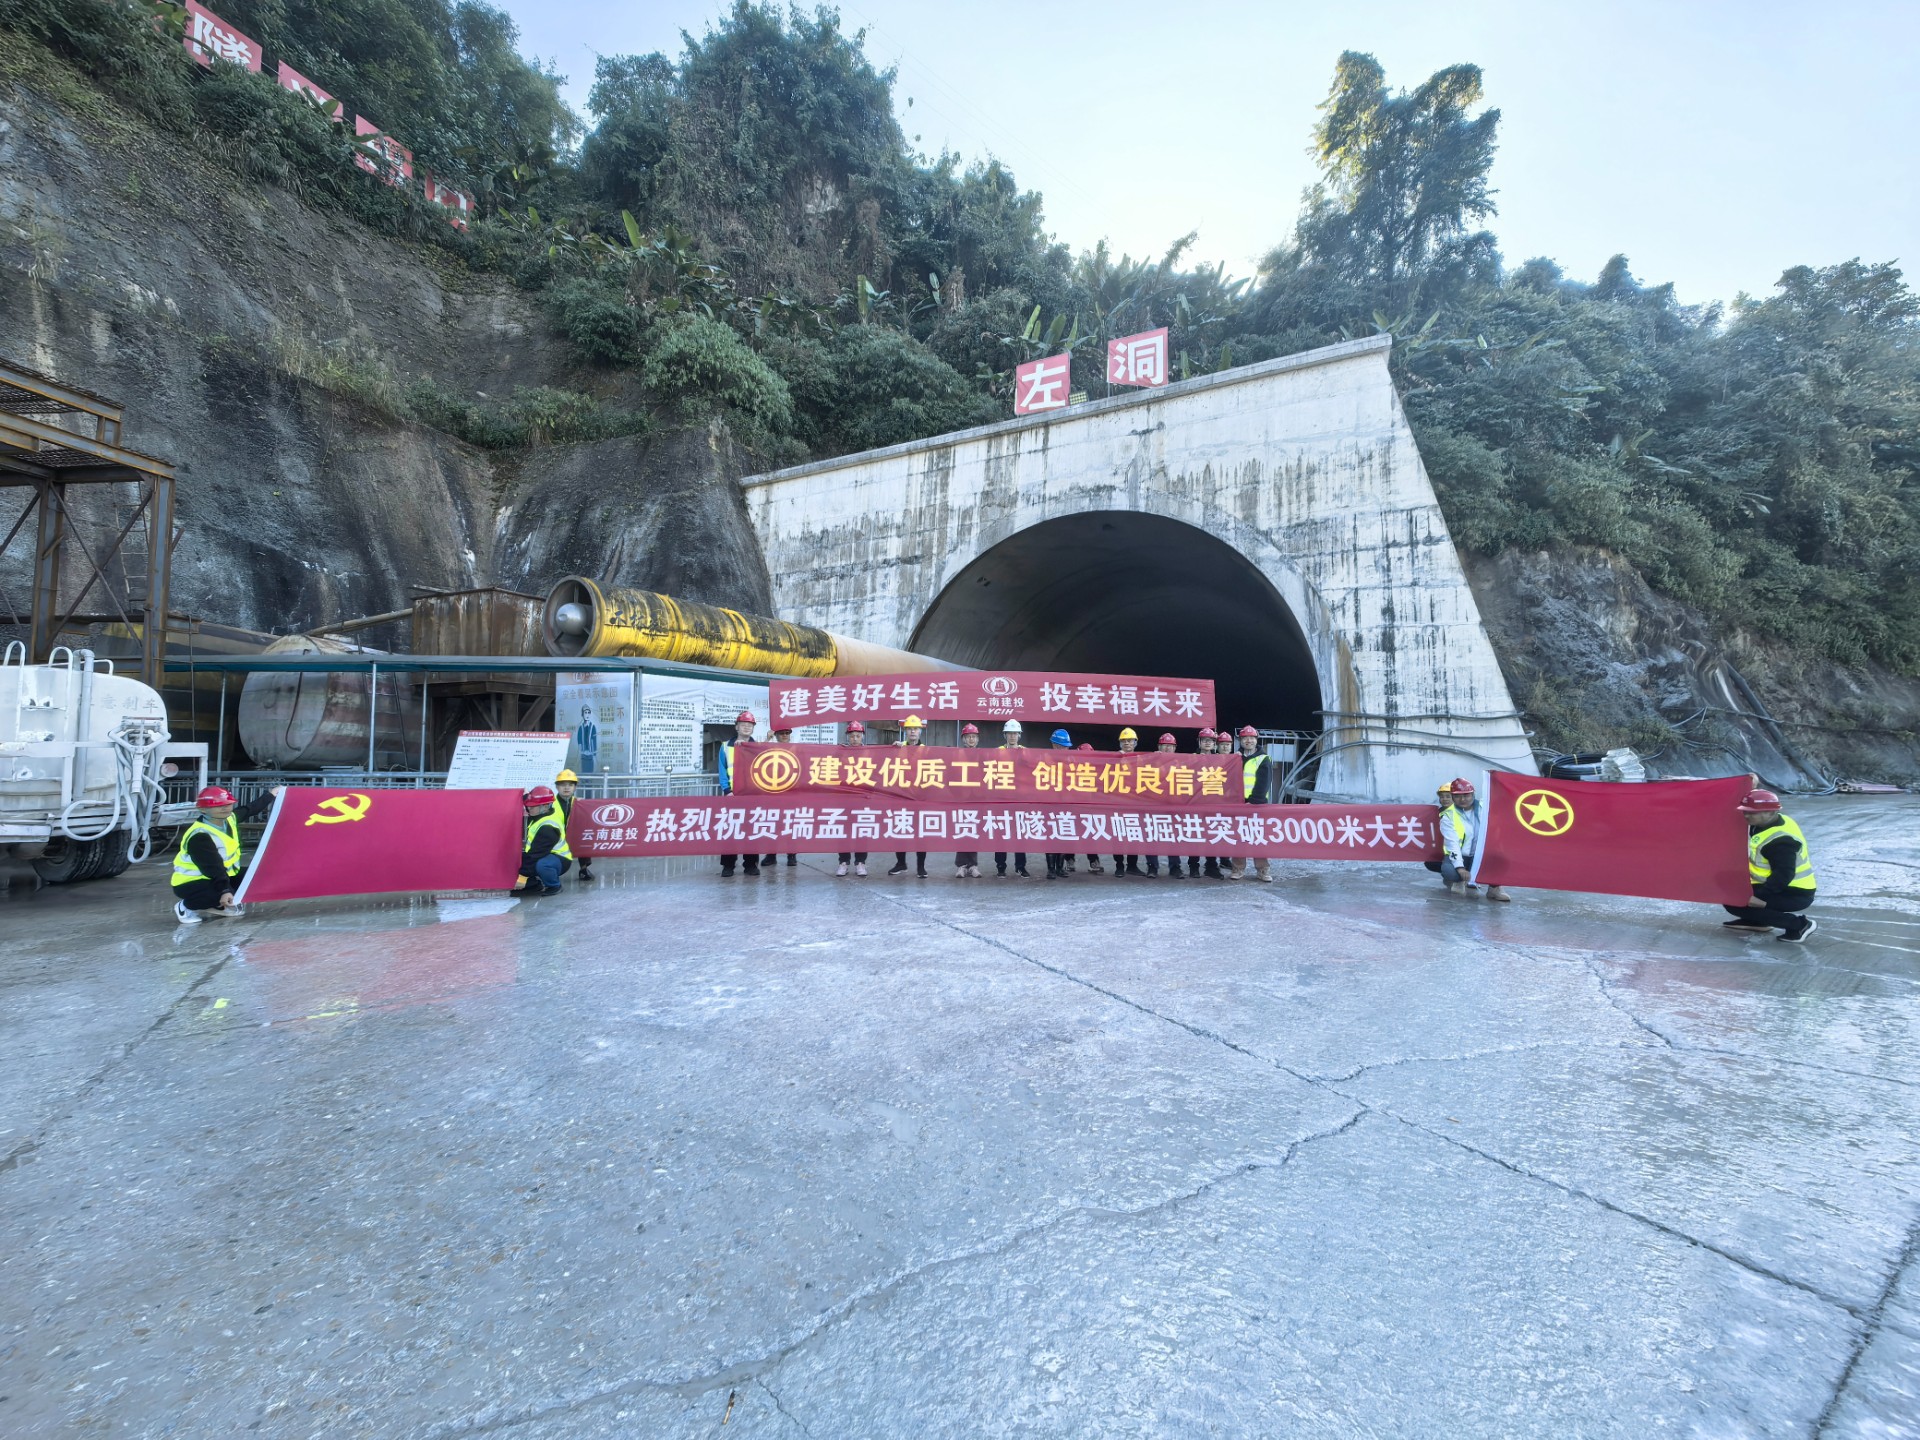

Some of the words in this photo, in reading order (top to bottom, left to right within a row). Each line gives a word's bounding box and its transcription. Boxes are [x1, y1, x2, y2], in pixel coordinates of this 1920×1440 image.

[1021, 363, 1066, 410] 左
[1113, 335, 1164, 384] 洞
[780, 681, 960, 719] 建美好生活
[1040, 682, 1204, 718] 投幸福未来
[977, 697, 1024, 708] 云南建投
[808, 756, 1015, 789] 建设优质工程
[1032, 762, 1227, 796] 创造优良信誉
[582, 828, 638, 840] 云南建投
[593, 842, 624, 850] YCIH
[644, 807, 1437, 849] 热烈祝贺瑞孟高速回贤村隧道双幅掘进突破3000米大关!
